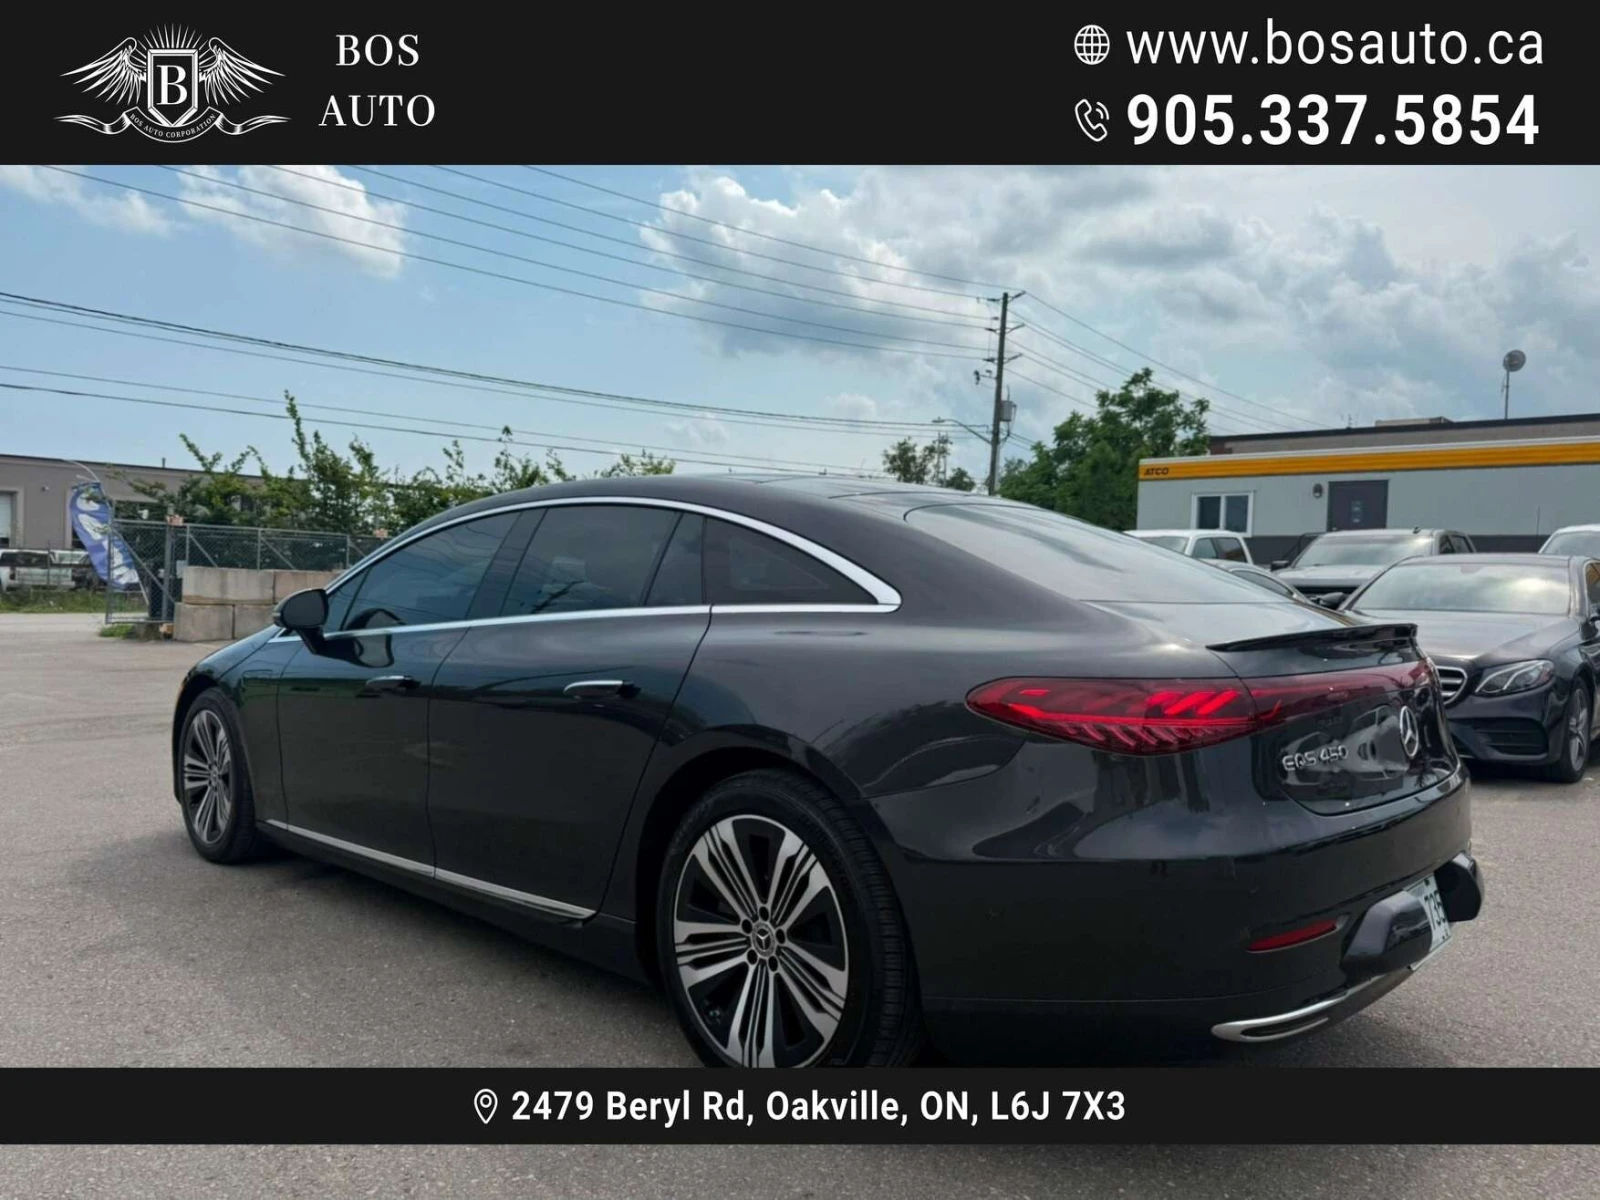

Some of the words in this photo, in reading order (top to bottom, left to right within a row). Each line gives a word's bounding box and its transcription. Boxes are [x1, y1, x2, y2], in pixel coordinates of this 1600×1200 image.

[1143, 467, 1169, 476] ATCO
[1282, 752, 1317, 772] EQS
[1319, 744, 1349, 763] 450
